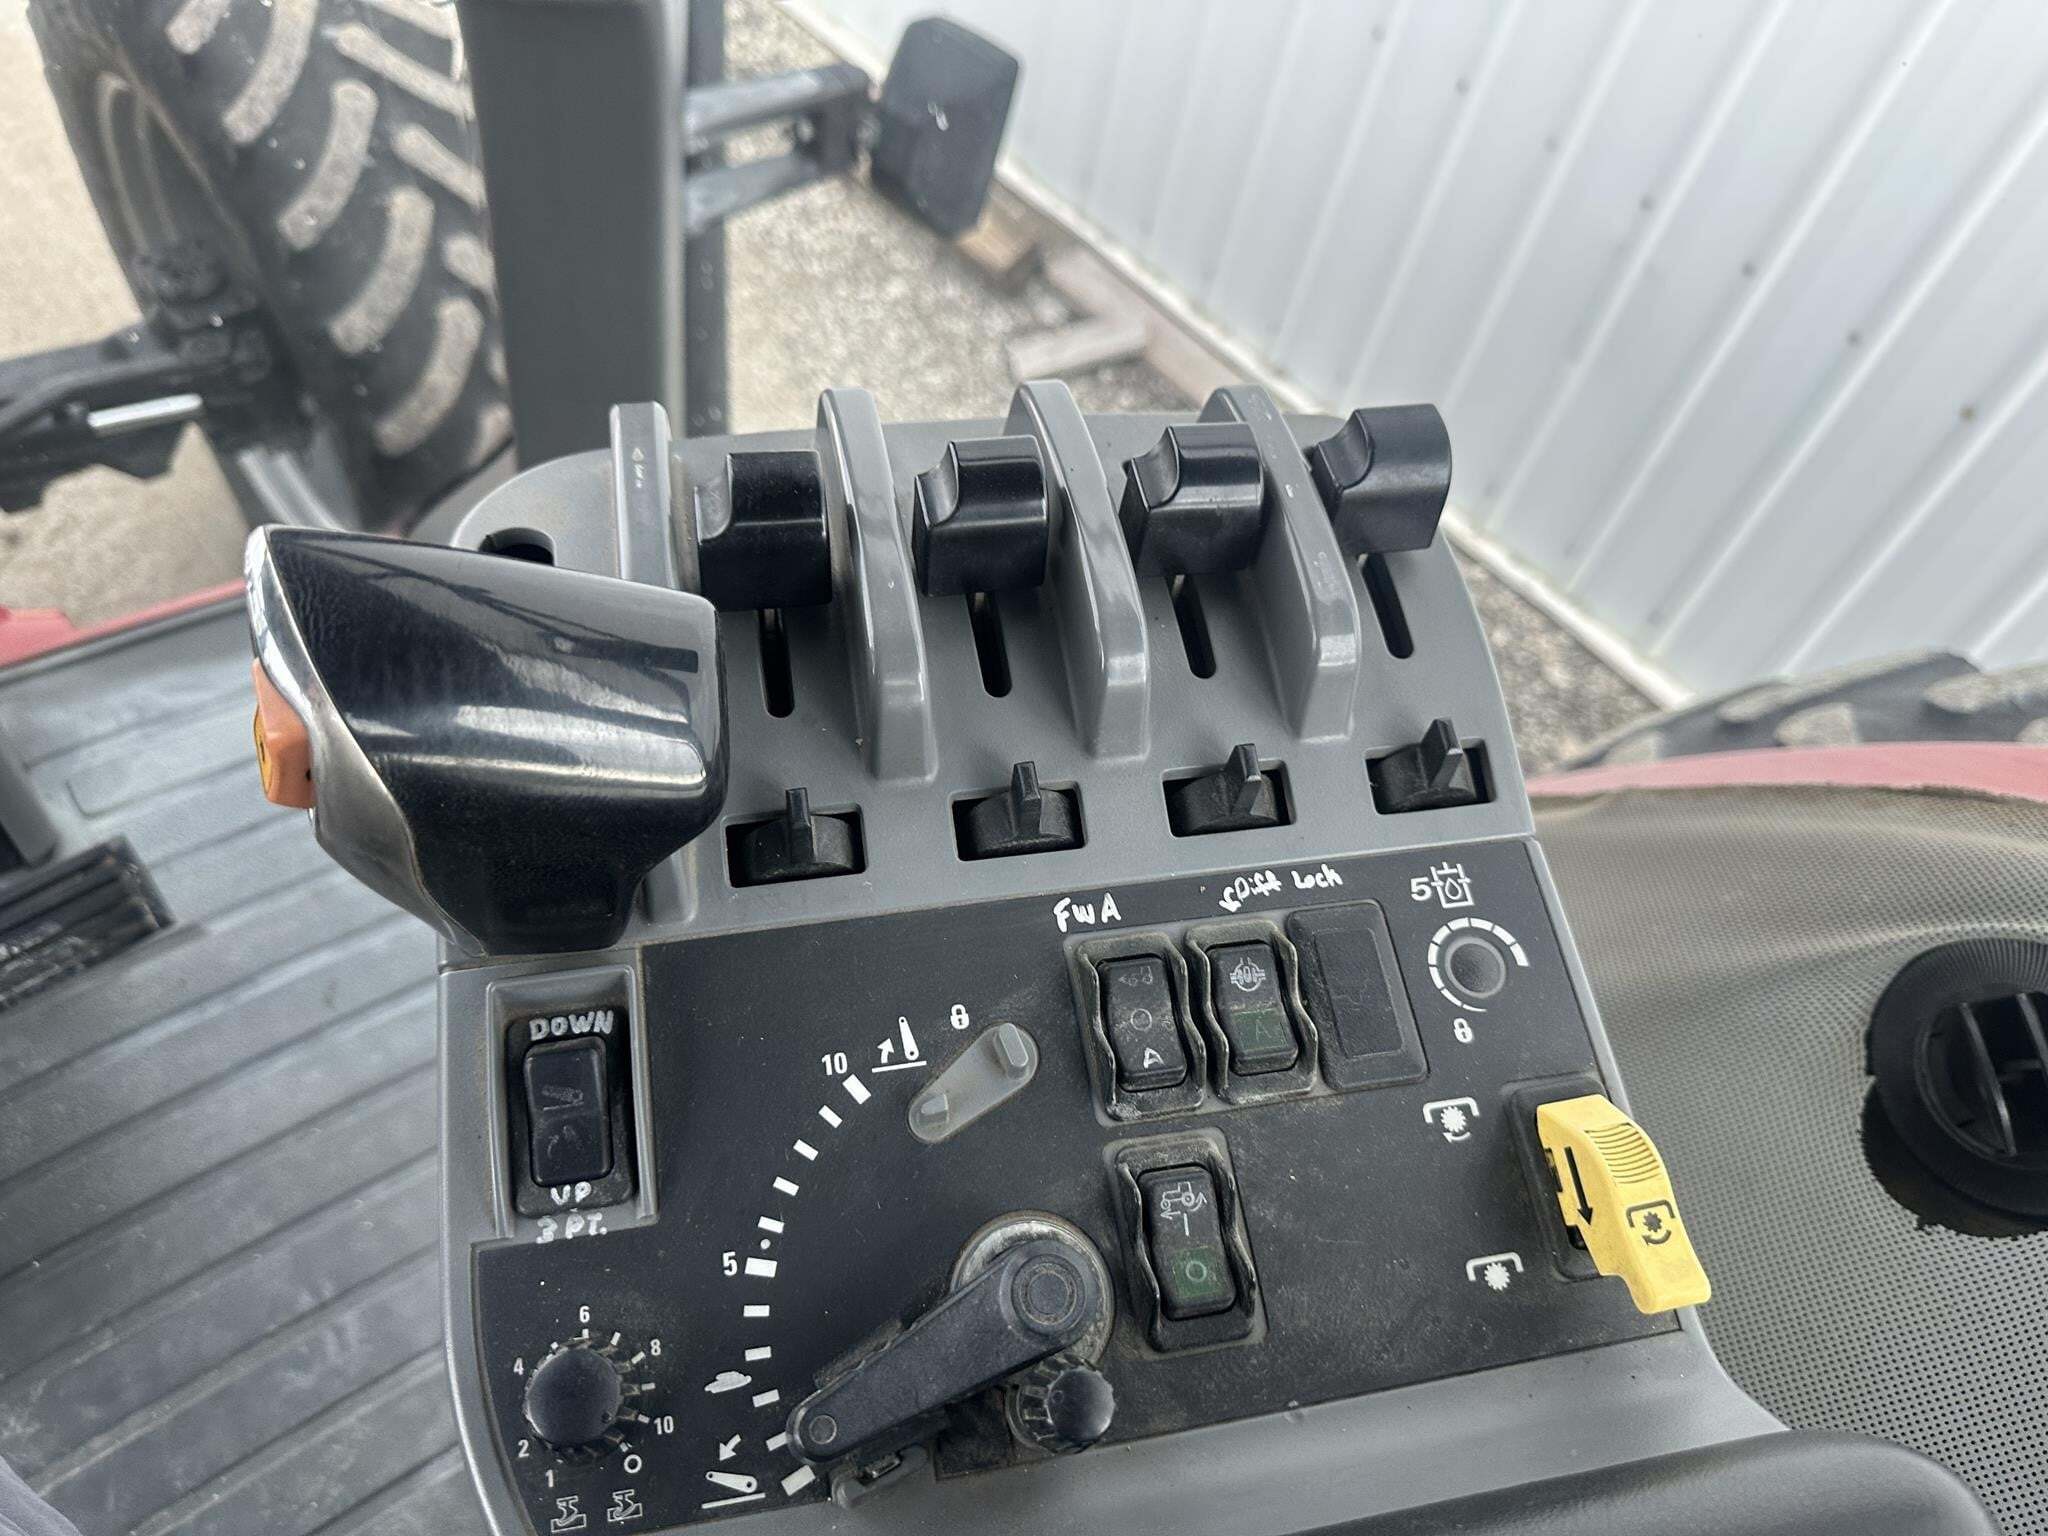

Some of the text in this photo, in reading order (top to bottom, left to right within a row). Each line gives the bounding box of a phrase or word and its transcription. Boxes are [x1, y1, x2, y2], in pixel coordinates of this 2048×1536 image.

[1410, 877, 1432, 902] 5
[529, 1010, 614, 1041] DOWN
[821, 1052, 848, 1077] 10
[1143, 1047, 1165, 1069] A
[551, 1181, 592, 1205] UP
[536, 1215, 558, 1244] 3
[723, 1251, 738, 1277] 5
[579, 1305, 590, 1323] 6
[650, 1339, 662, 1356] 8
[513, 1358, 524, 1375] 4
[653, 1416, 675, 1435] 10
[518, 1439, 529, 1458] 2
[545, 1470, 554, 1487] 1
